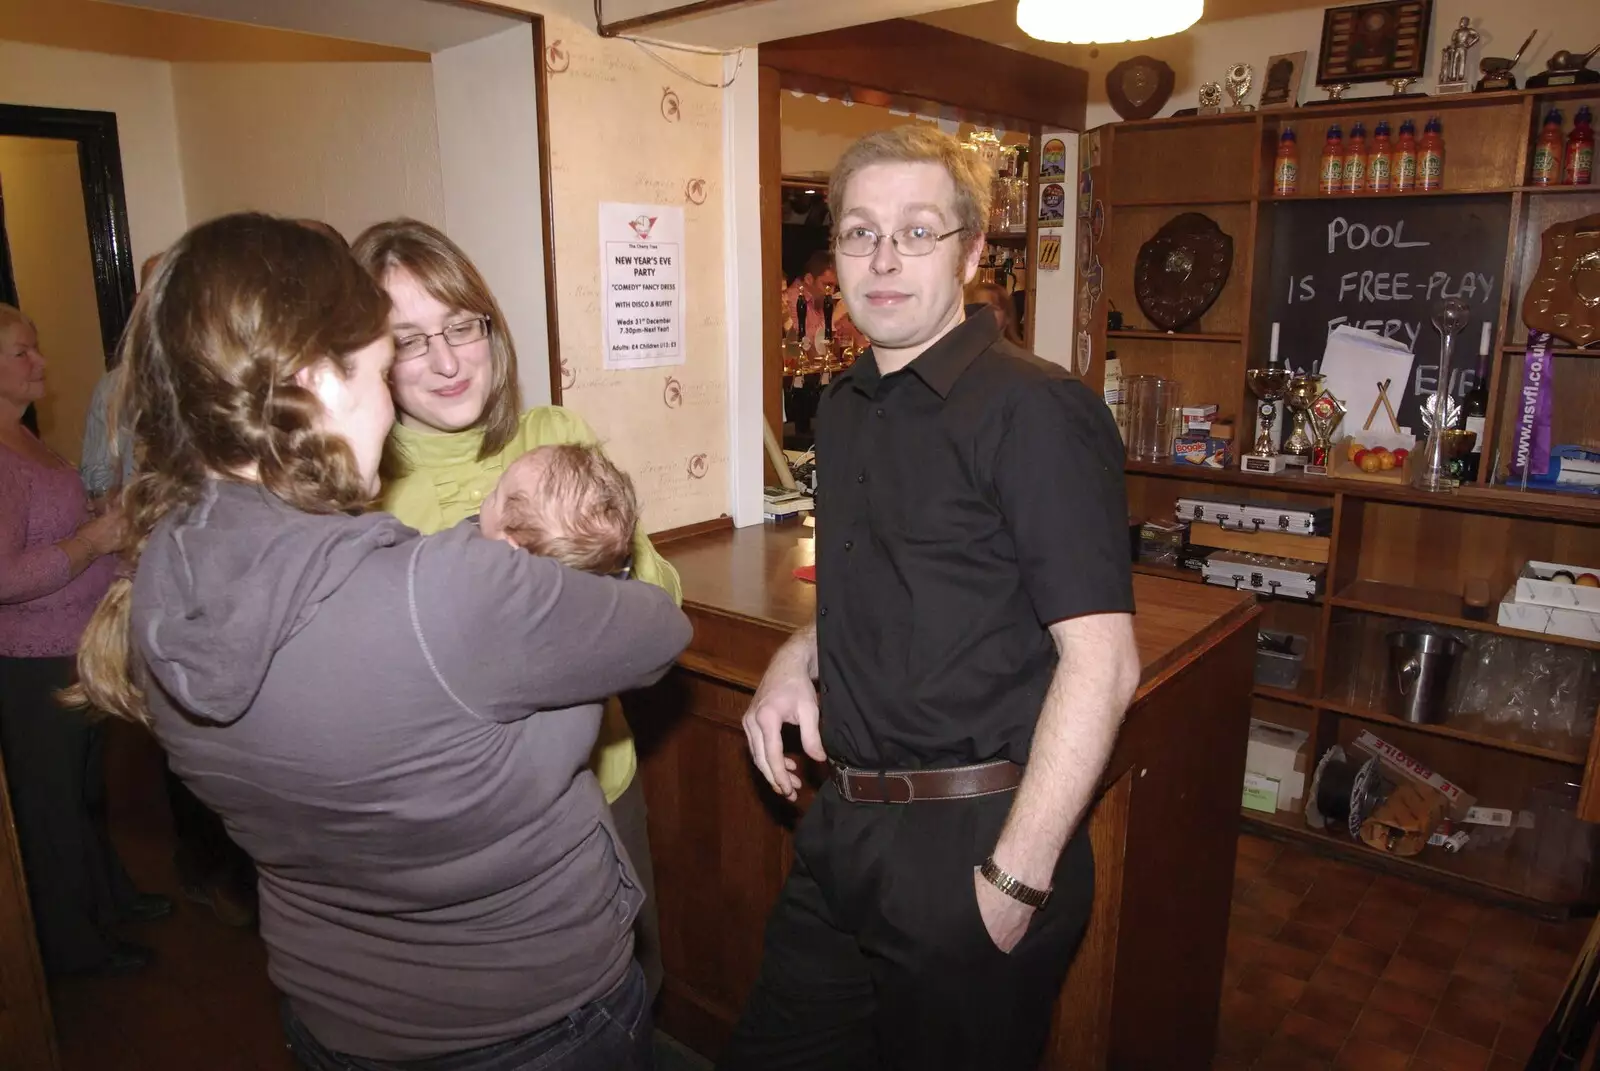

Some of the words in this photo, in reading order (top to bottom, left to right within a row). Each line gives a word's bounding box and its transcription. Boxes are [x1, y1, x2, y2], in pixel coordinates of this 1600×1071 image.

[1327, 216, 1431, 254] POOL
[615, 256, 632, 265] NEW
[633, 256, 658, 266] YEAR'S
[659, 256, 672, 266] EVE
[633, 268, 656, 277] PARTY
[611, 283, 641, 291] "COMEDY"
[642, 283, 659, 291] FANCY
[660, 283, 676, 291] DRESS
[1287, 274, 1316, 304] IS
[1338, 269, 1495, 304] FREE-PLAY
[615, 301, 631, 309] WITH
[631, 300, 649, 308] DISCO
[655, 300, 673, 308] BUFFET
[646, 317, 671, 325] December
[620, 327, 656, 335] 7.30pm-Next
[1327, 315, 1421, 353] ERY
[639, 342, 660, 350] Children
[1176, 442, 1206, 452] Boggle
[1375, 739, 1433, 780] FRAGILE
